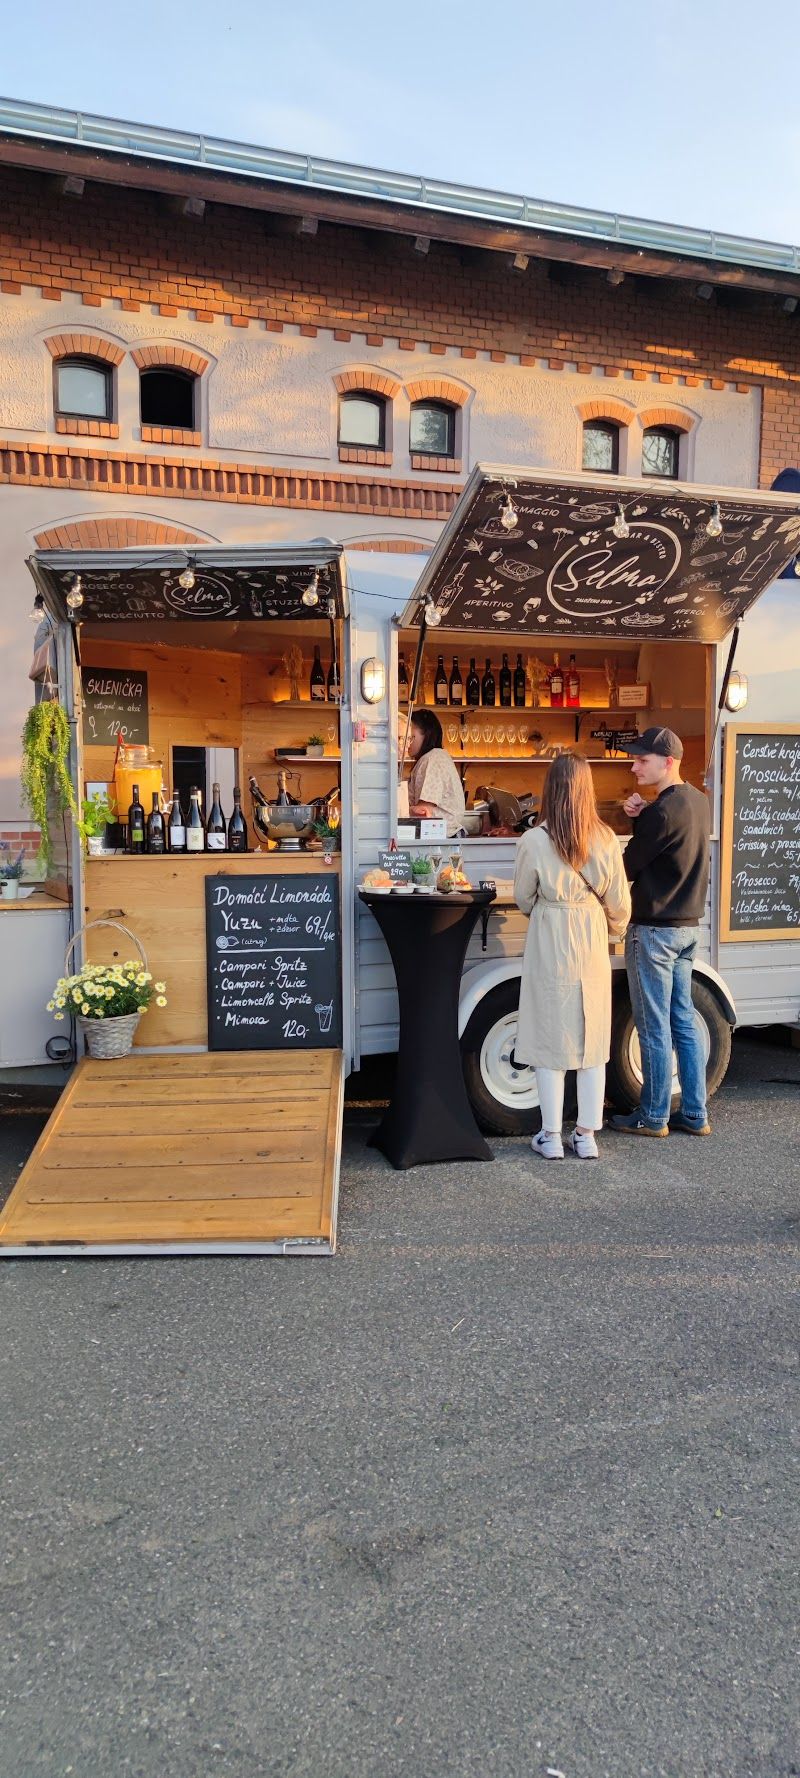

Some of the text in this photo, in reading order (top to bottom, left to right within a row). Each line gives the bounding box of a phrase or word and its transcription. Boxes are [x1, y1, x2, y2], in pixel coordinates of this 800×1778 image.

[464, 599, 514, 609] APERITIVO
[86, 678, 143, 697] SKLENIČKA
[742, 823, 784, 835] sandwich
[735, 871, 778, 888] Prosecco
[213, 883, 332, 906] Domácí Limonáda
[220, 909, 262, 931] Yuzu
[219, 956, 307, 980] Campari Spritz
[221, 977, 266, 995] Campari
[277, 975, 307, 989] Juice
[221, 991, 312, 1010] Limoncello Spritz
[225, 1012, 269, 1026] Mimosa
